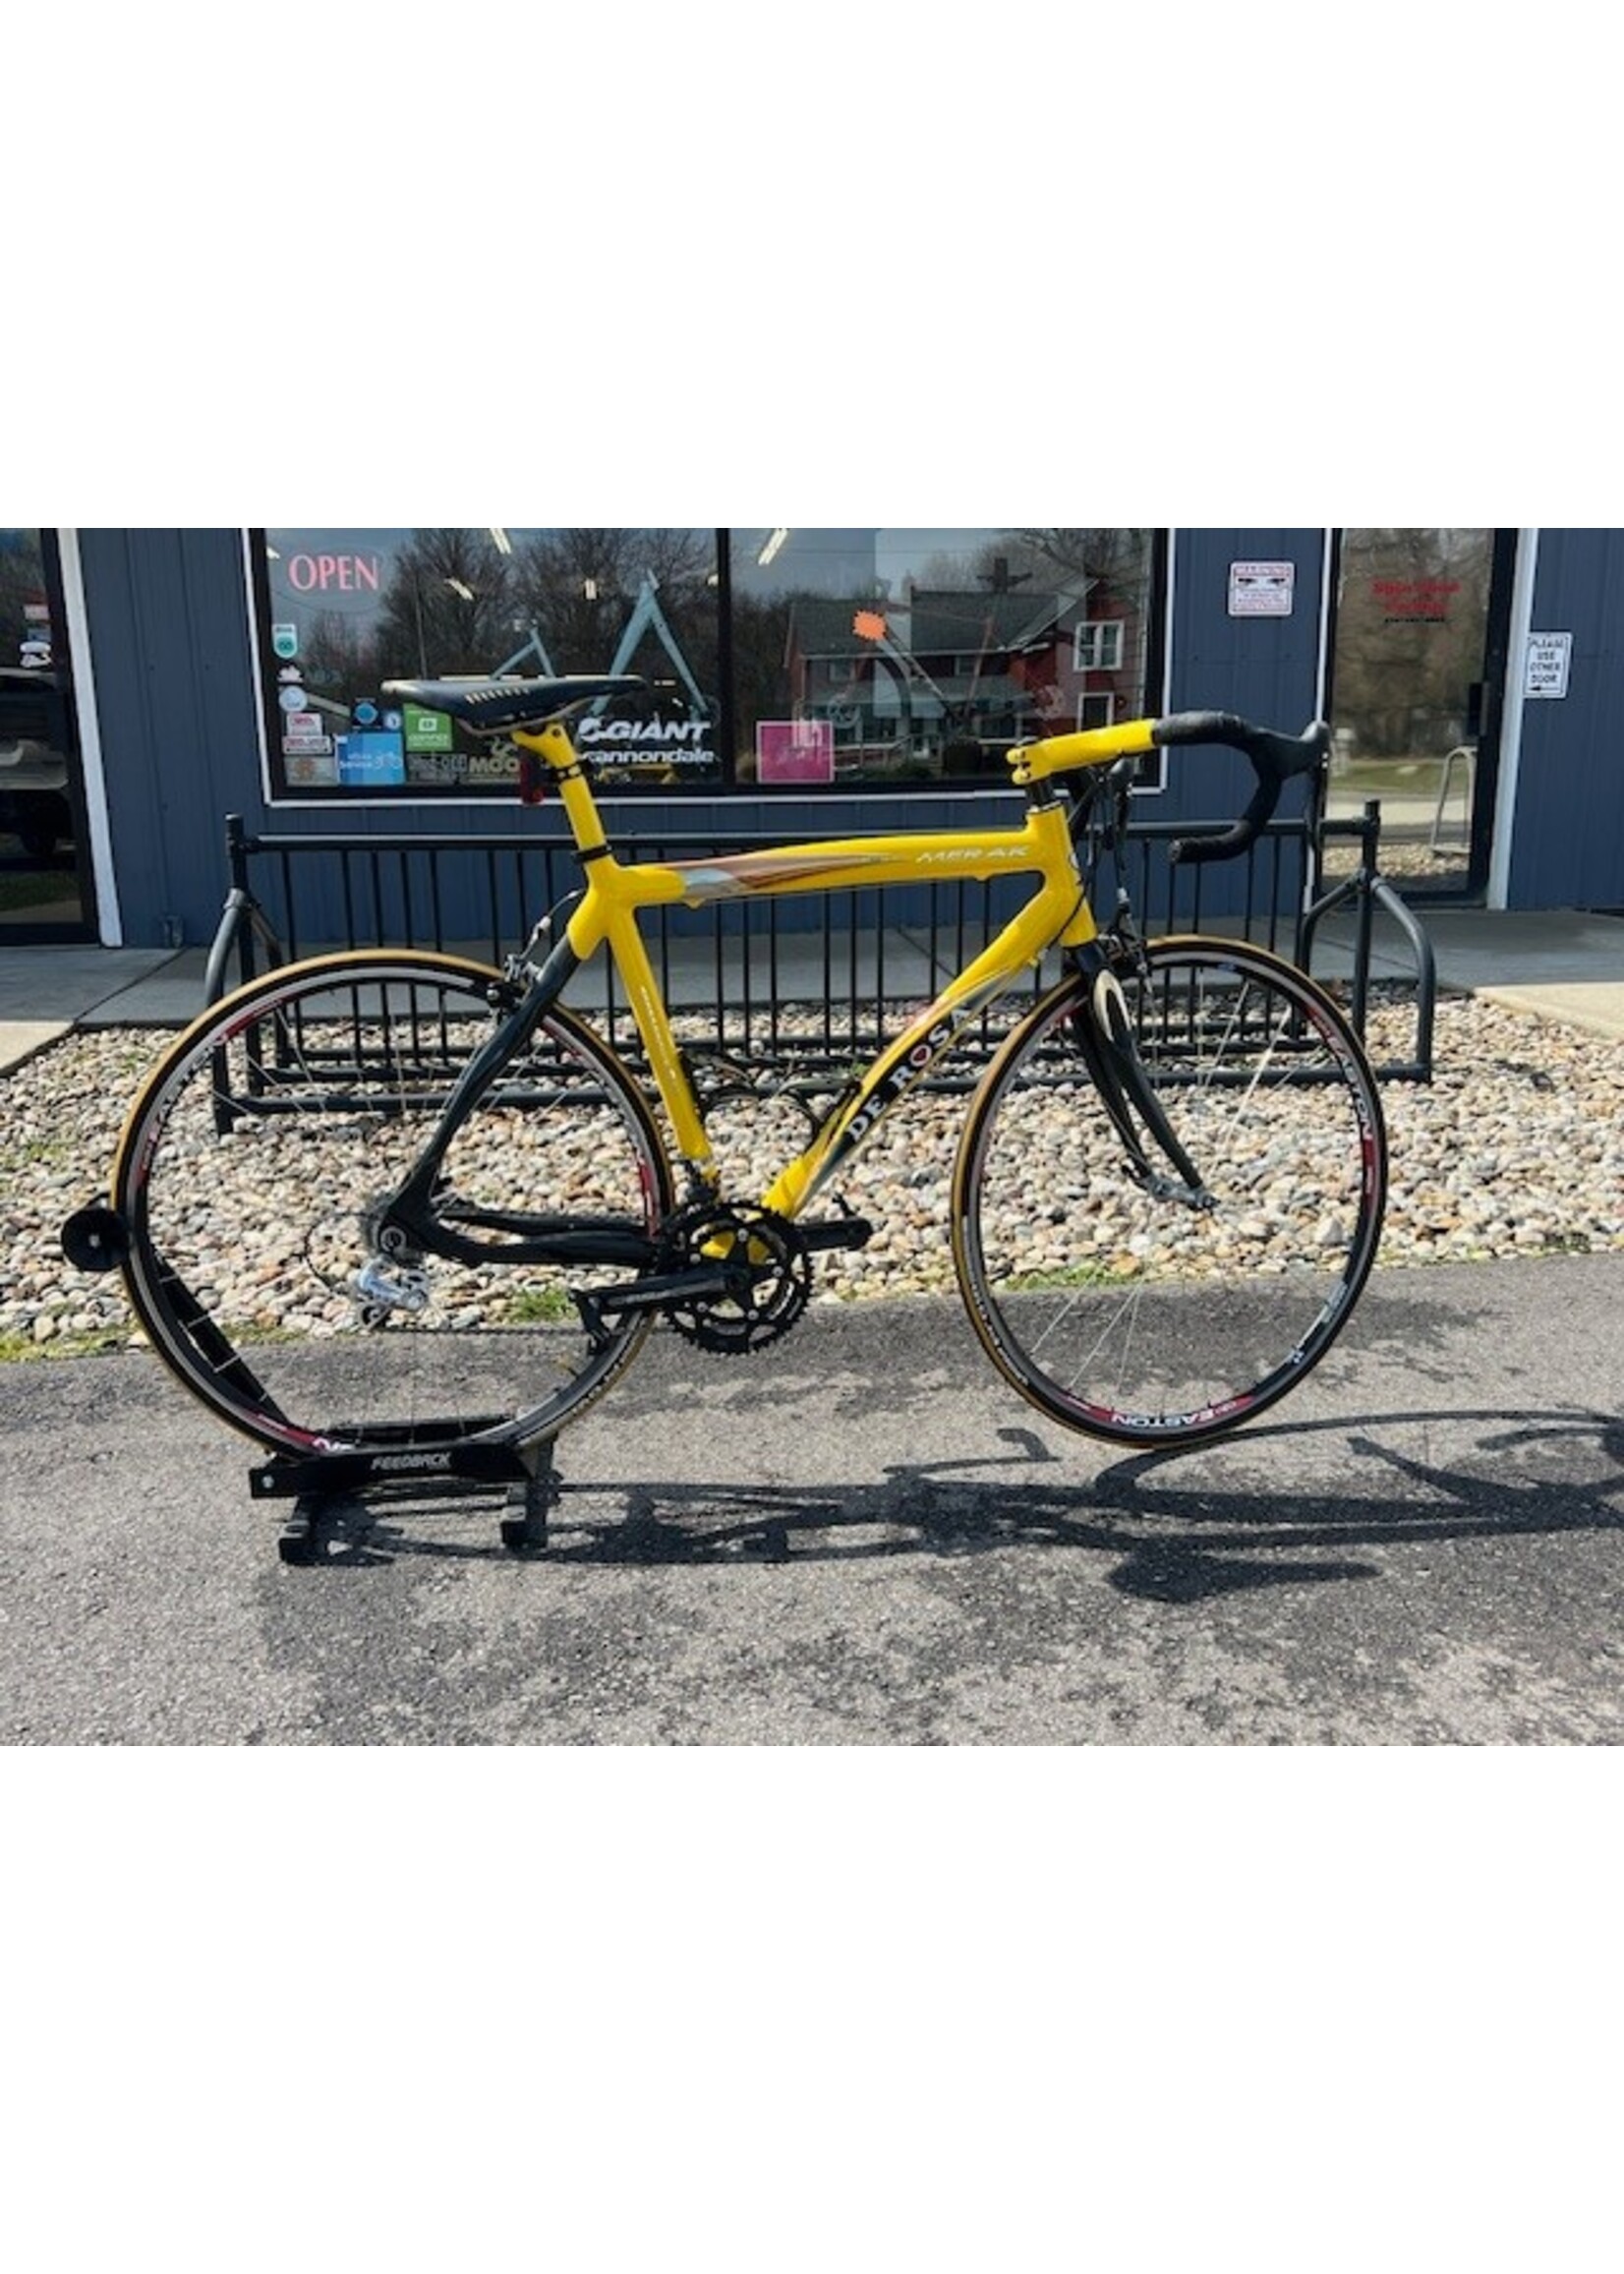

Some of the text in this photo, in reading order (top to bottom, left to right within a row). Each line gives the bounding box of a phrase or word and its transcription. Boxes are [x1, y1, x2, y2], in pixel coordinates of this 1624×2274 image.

[288, 554, 378, 591] OPEN
[1531, 638, 1565, 648] PLEASE
[1537, 651, 1555, 661] USE
[1530, 662, 1561, 671] OTHER
[1532, 673, 1558, 683] DOOR
[608, 720, 712, 740] GIANT
[578, 747, 715, 763] cannondale
[847, 1009, 971, 1142] DE ROSA
[1111, 1408, 1215, 1428] EASTON
[371, 1452, 452, 1471] FEEDBACK
